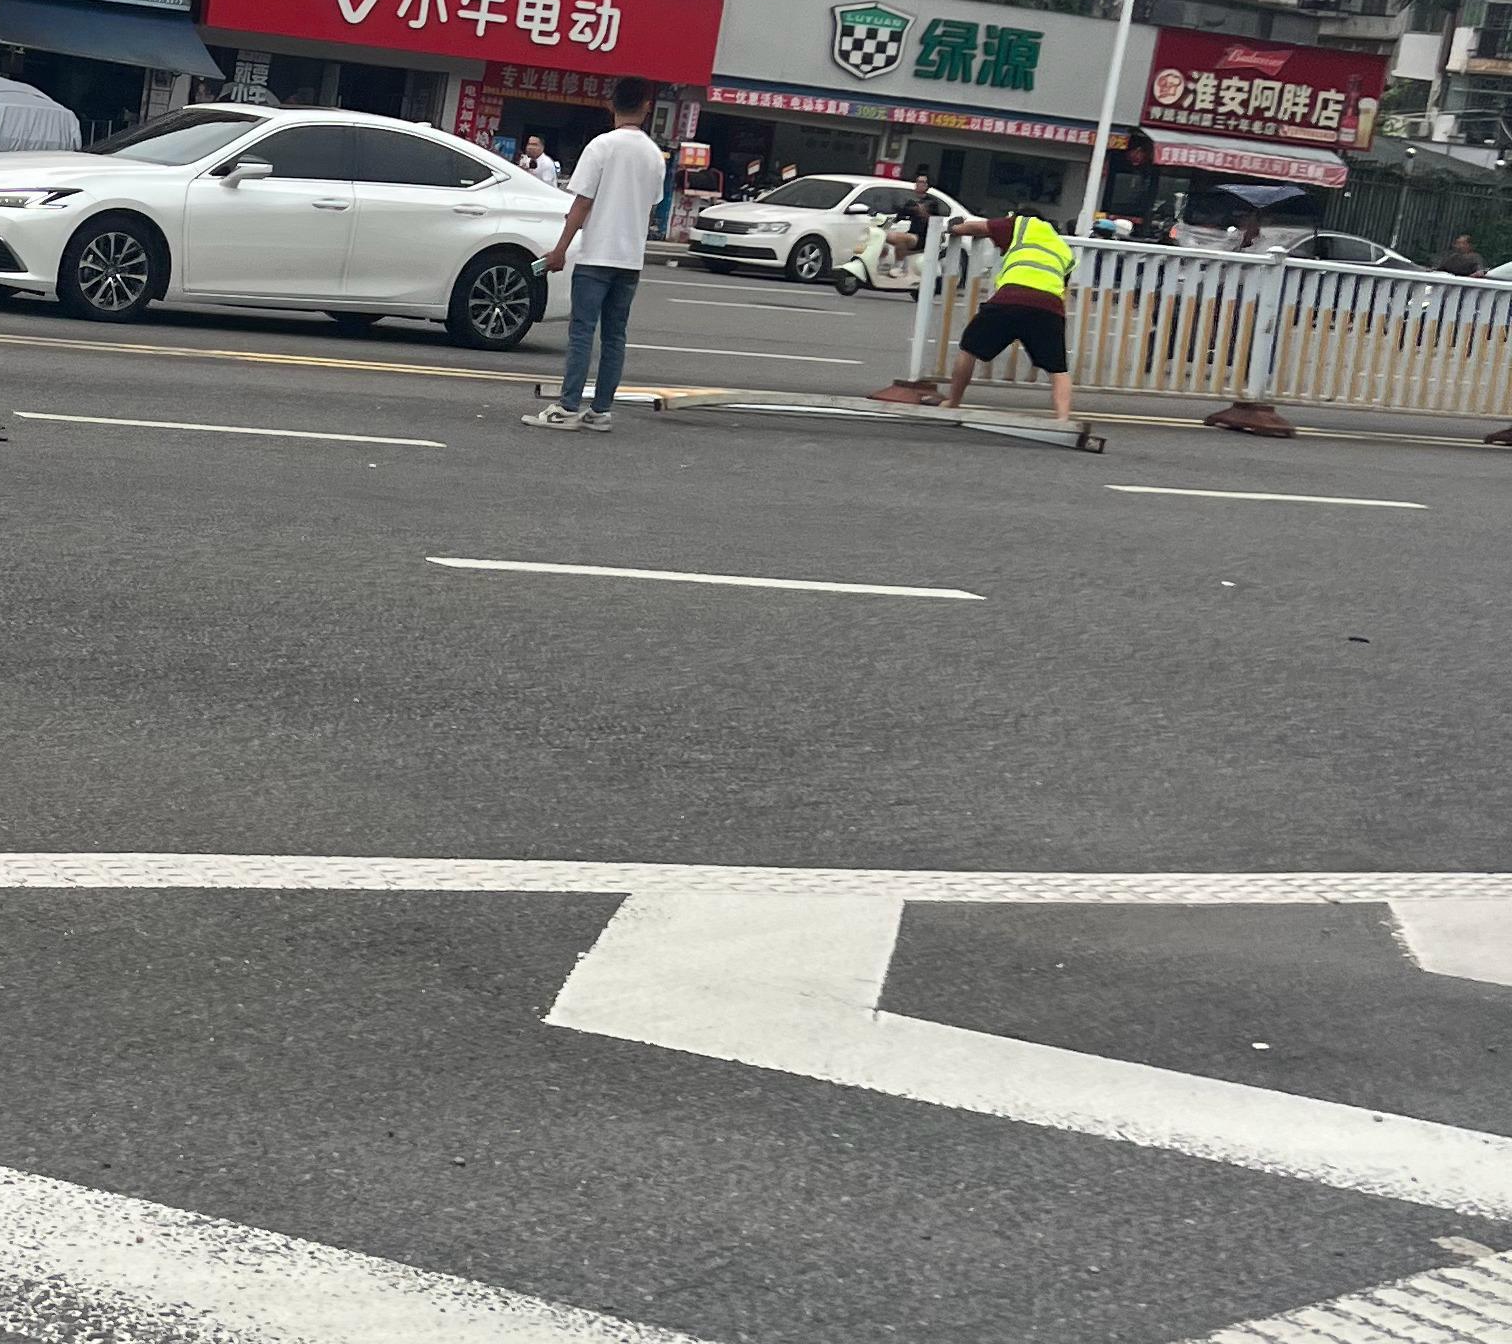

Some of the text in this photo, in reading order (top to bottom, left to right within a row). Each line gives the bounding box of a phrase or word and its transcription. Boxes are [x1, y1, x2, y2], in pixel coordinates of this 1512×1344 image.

[845, 12, 903, 27] LUYUAN
[913, 17, 1046, 92] 绿源
[1181, 70, 1347, 130] 淮安阿胖店
